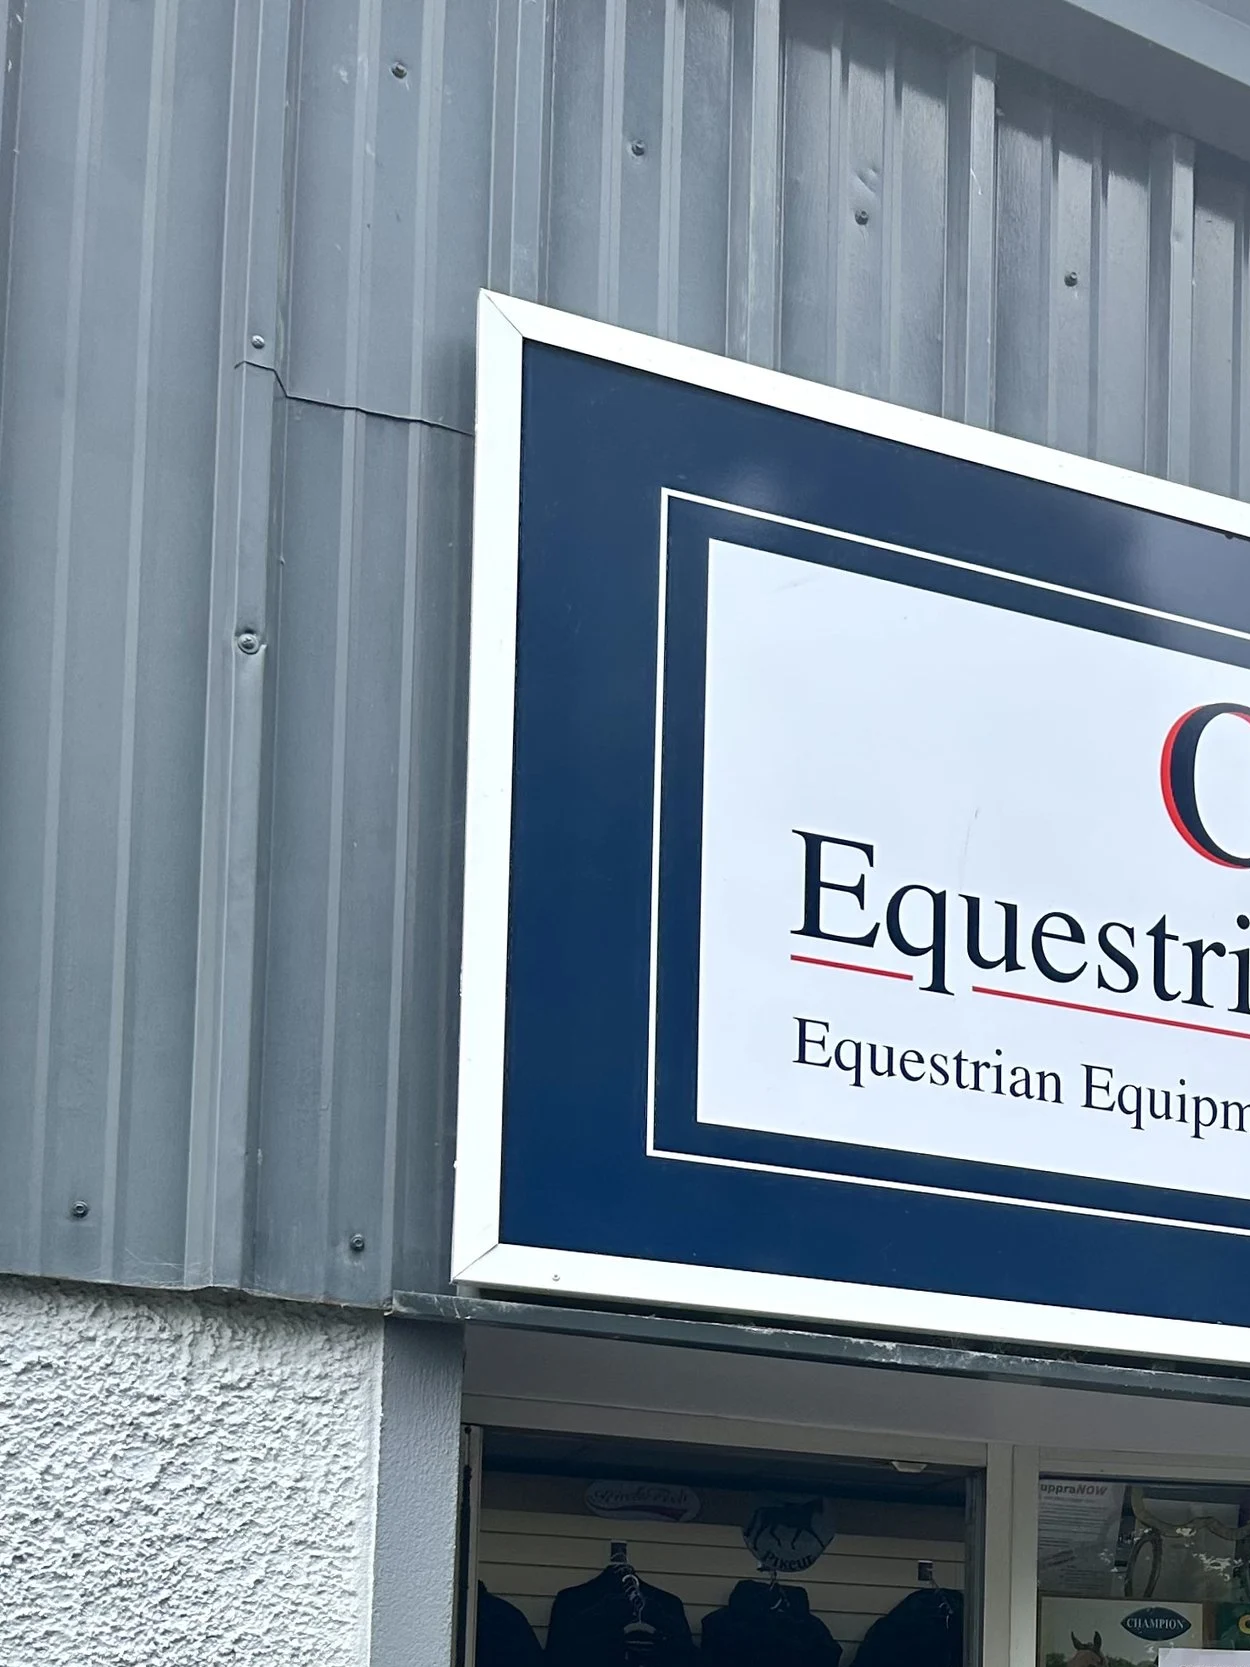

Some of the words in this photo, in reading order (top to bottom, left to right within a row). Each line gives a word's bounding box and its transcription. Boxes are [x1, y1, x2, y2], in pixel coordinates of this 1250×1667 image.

[792, 1017, 1064, 1104] Equestrian
[1040, 1484, 1108, 1496] uppraNOW
[1126, 1617, 1184, 1629] CHAMPION
